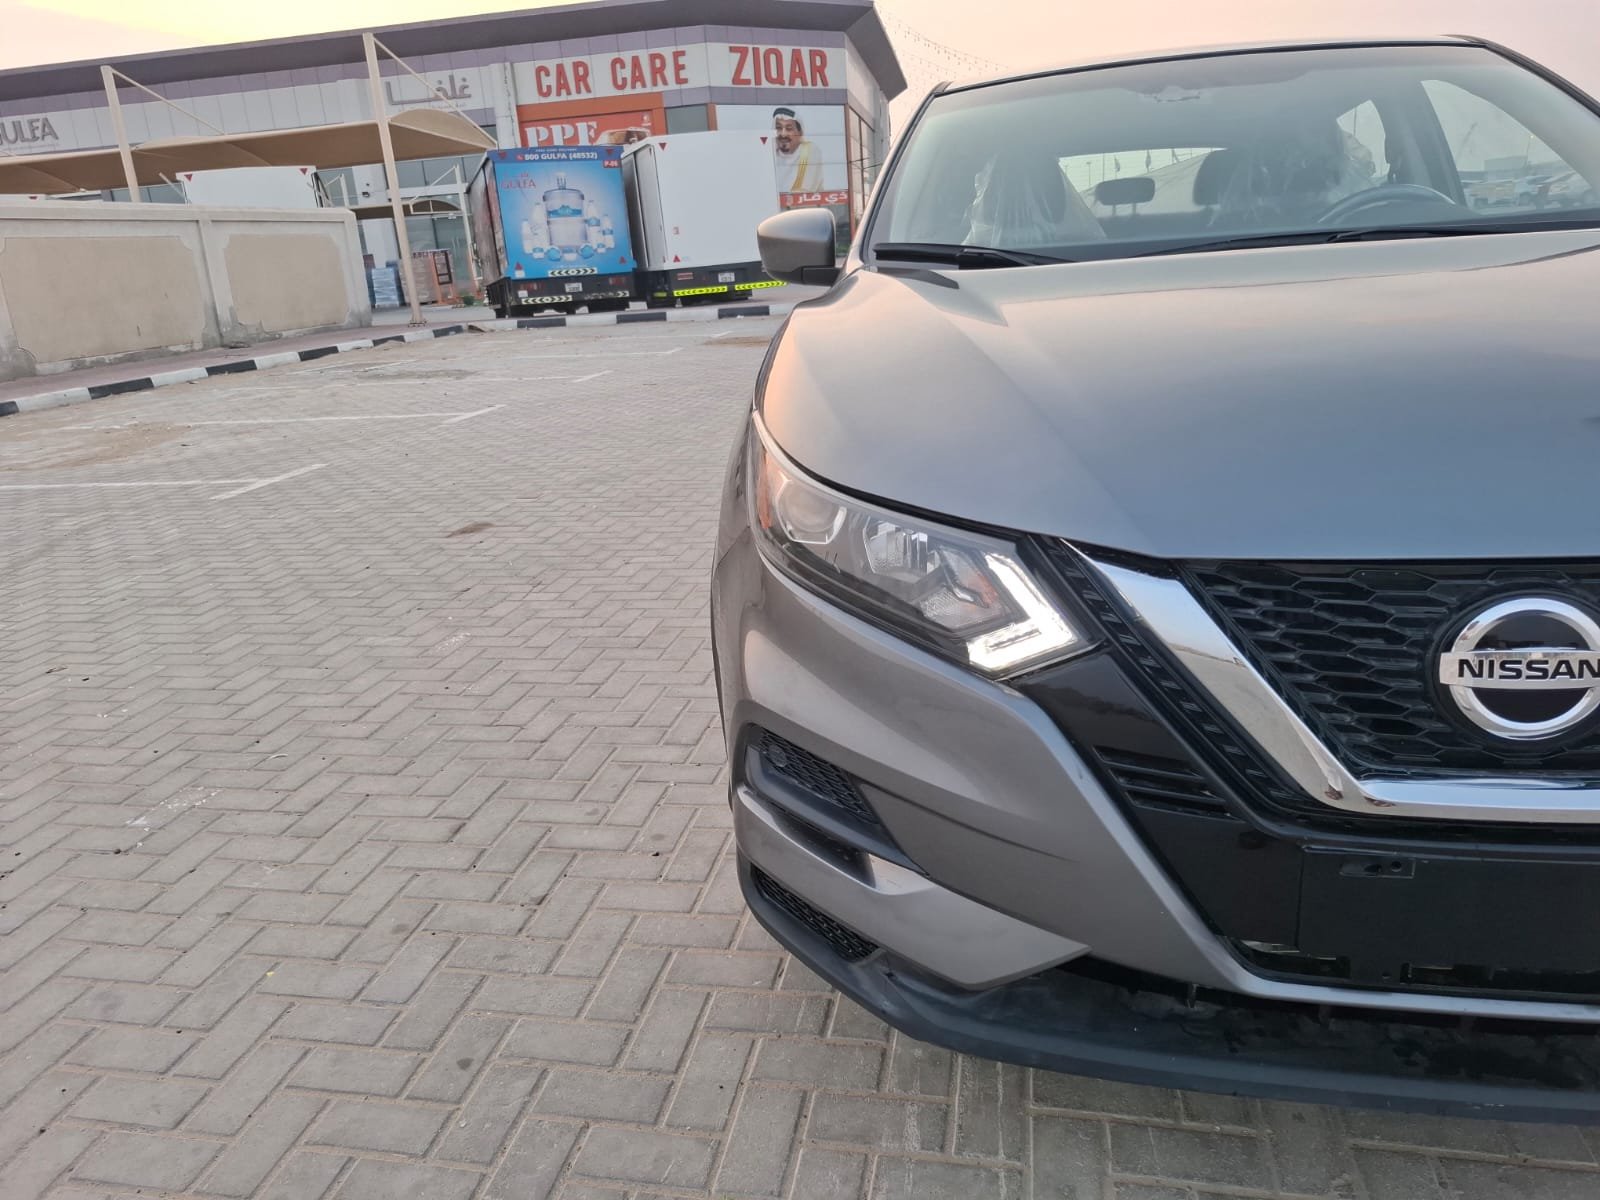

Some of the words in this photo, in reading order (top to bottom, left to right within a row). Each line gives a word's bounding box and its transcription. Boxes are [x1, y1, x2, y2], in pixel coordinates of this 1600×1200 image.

[535, 61, 592, 97] CAR
[610, 50, 689, 90] CARE
[729, 46, 829, 87] ZIQAR
[384, 74, 472, 106] غلفا
[0, 117, 59, 145] ULFA
[1458, 659, 1600, 679] NISSAN
